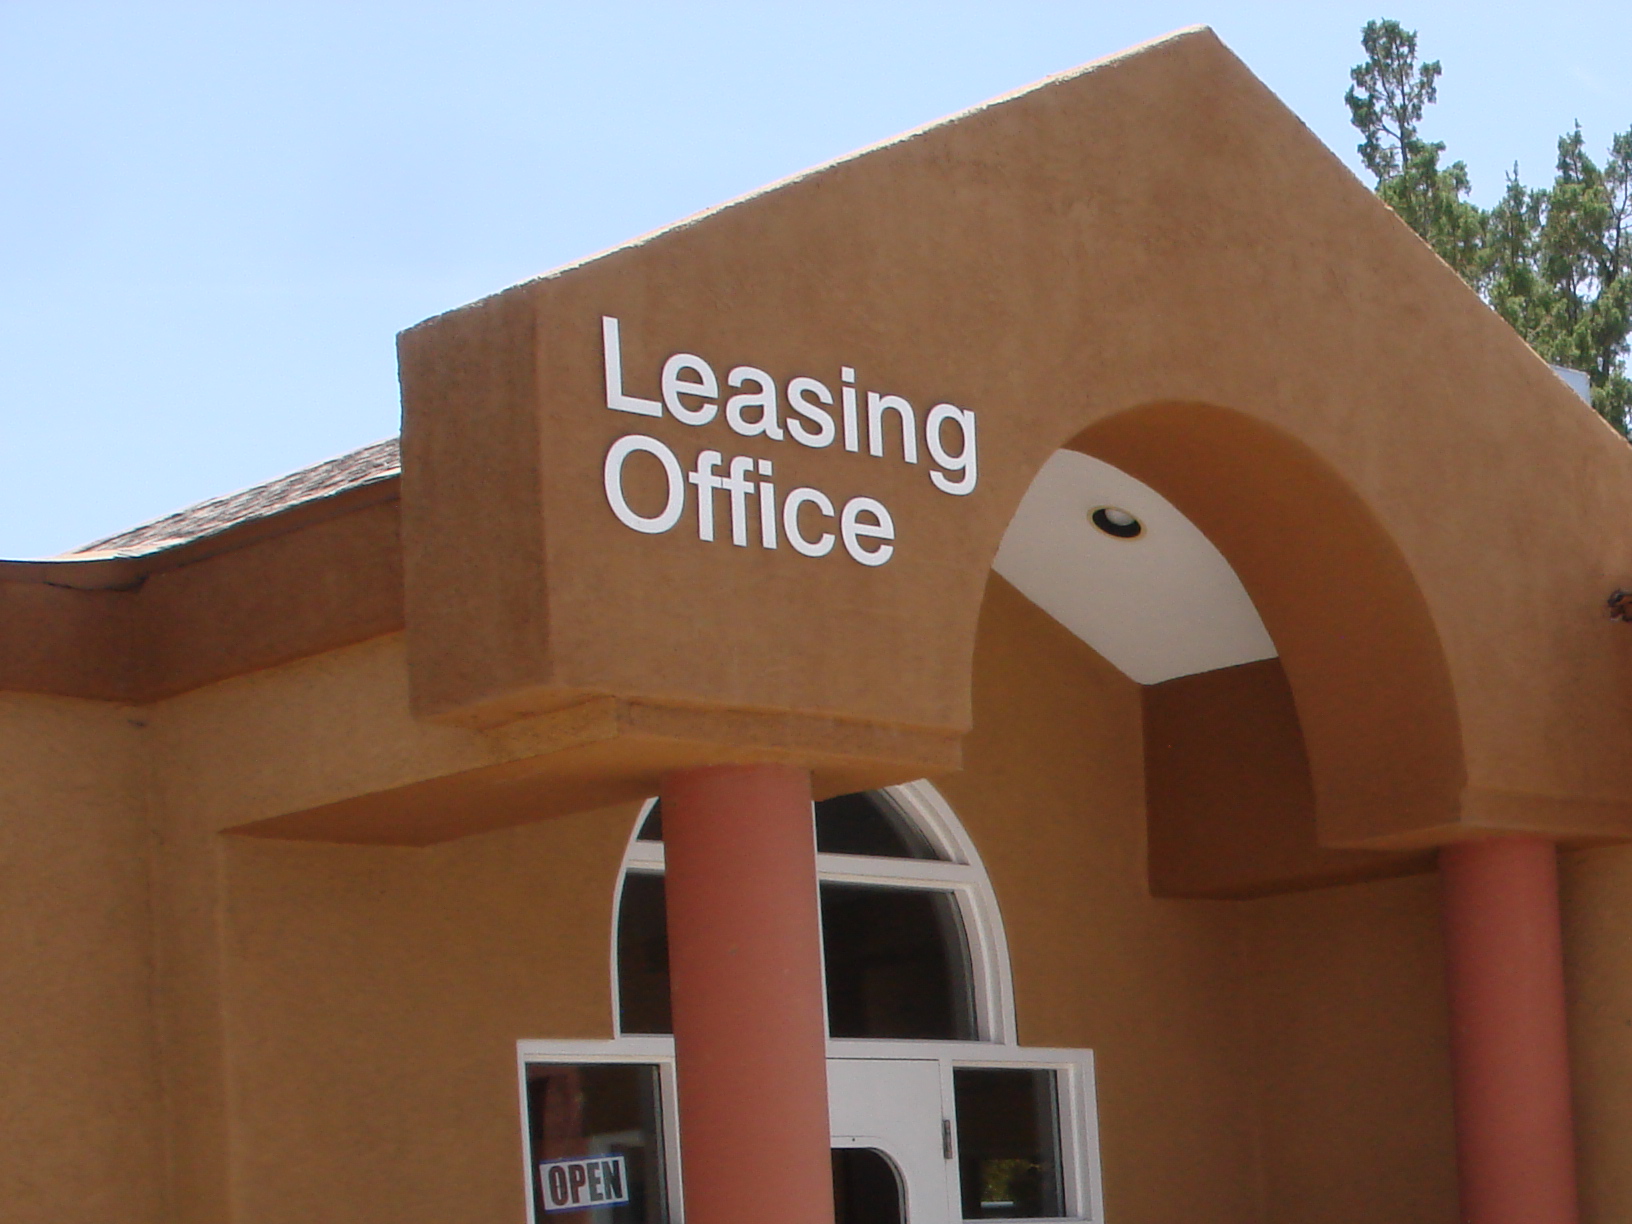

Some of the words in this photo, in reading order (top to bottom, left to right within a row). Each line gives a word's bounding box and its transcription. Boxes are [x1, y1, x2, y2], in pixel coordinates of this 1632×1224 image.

[602, 315, 979, 496] Leasing
[603, 434, 895, 567] Office
[548, 1160, 623, 1206] OPEN
